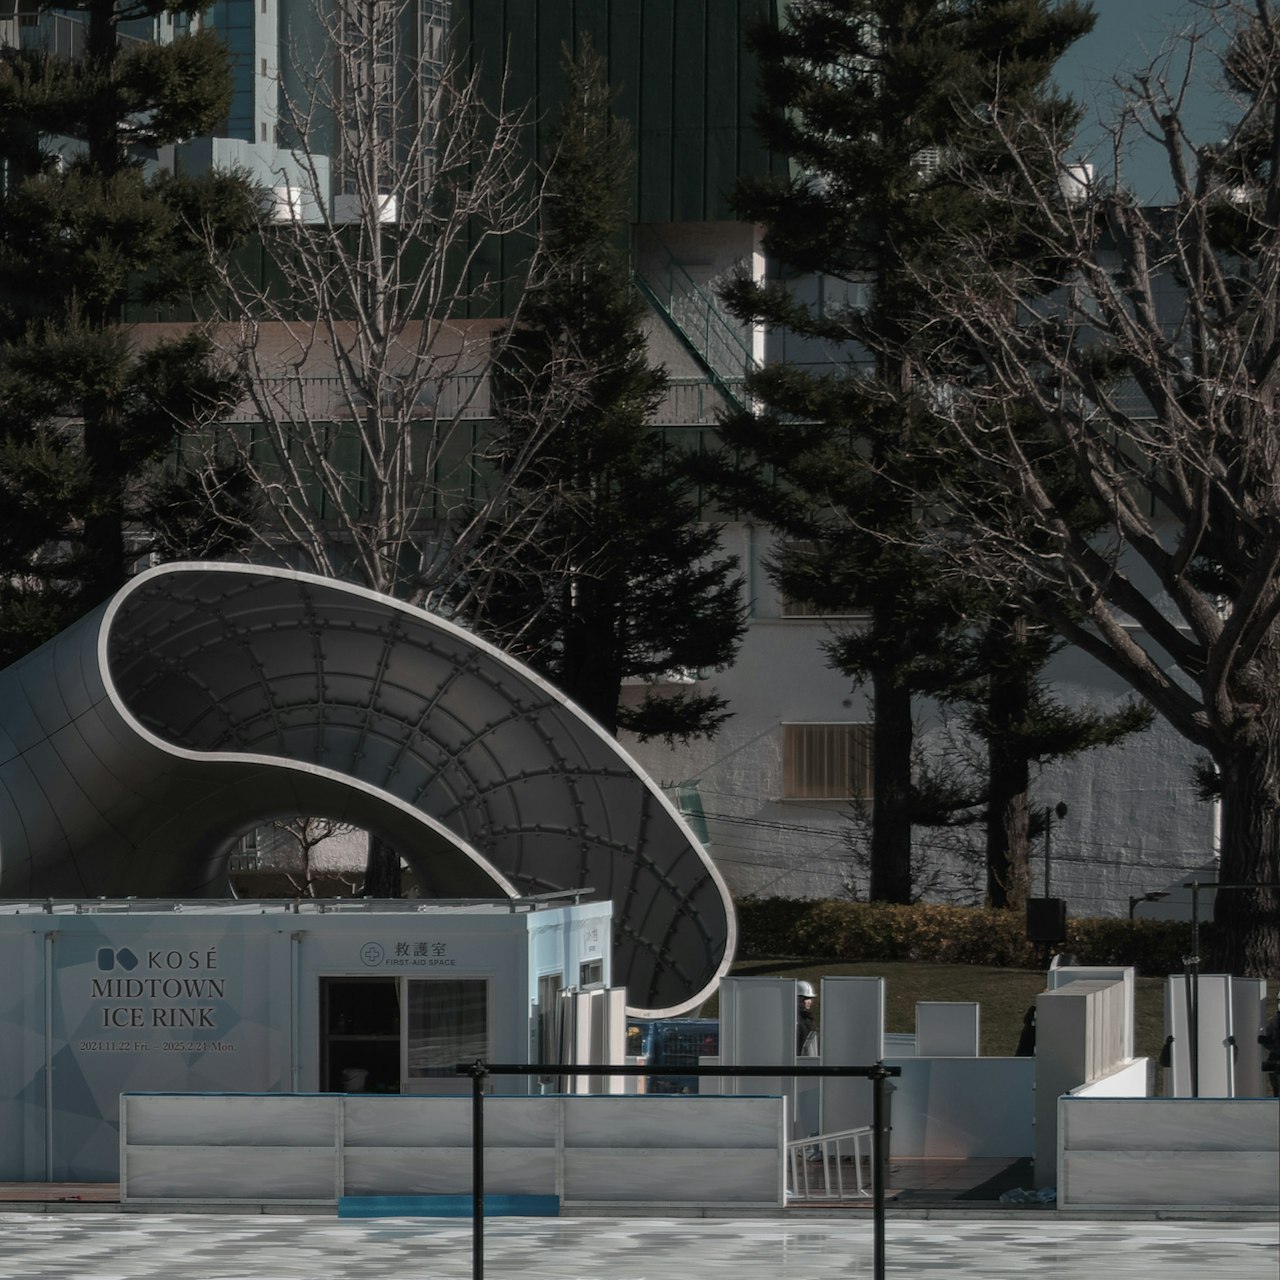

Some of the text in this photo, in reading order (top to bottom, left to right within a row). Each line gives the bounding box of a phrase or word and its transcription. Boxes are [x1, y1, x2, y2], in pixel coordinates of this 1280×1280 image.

[149, 947, 216, 969] KOSÉ
[395, 942, 446, 956] 救護室
[92, 979, 224, 998] MIDTOWN
[104, 1008, 214, 1027] ICE RINK
